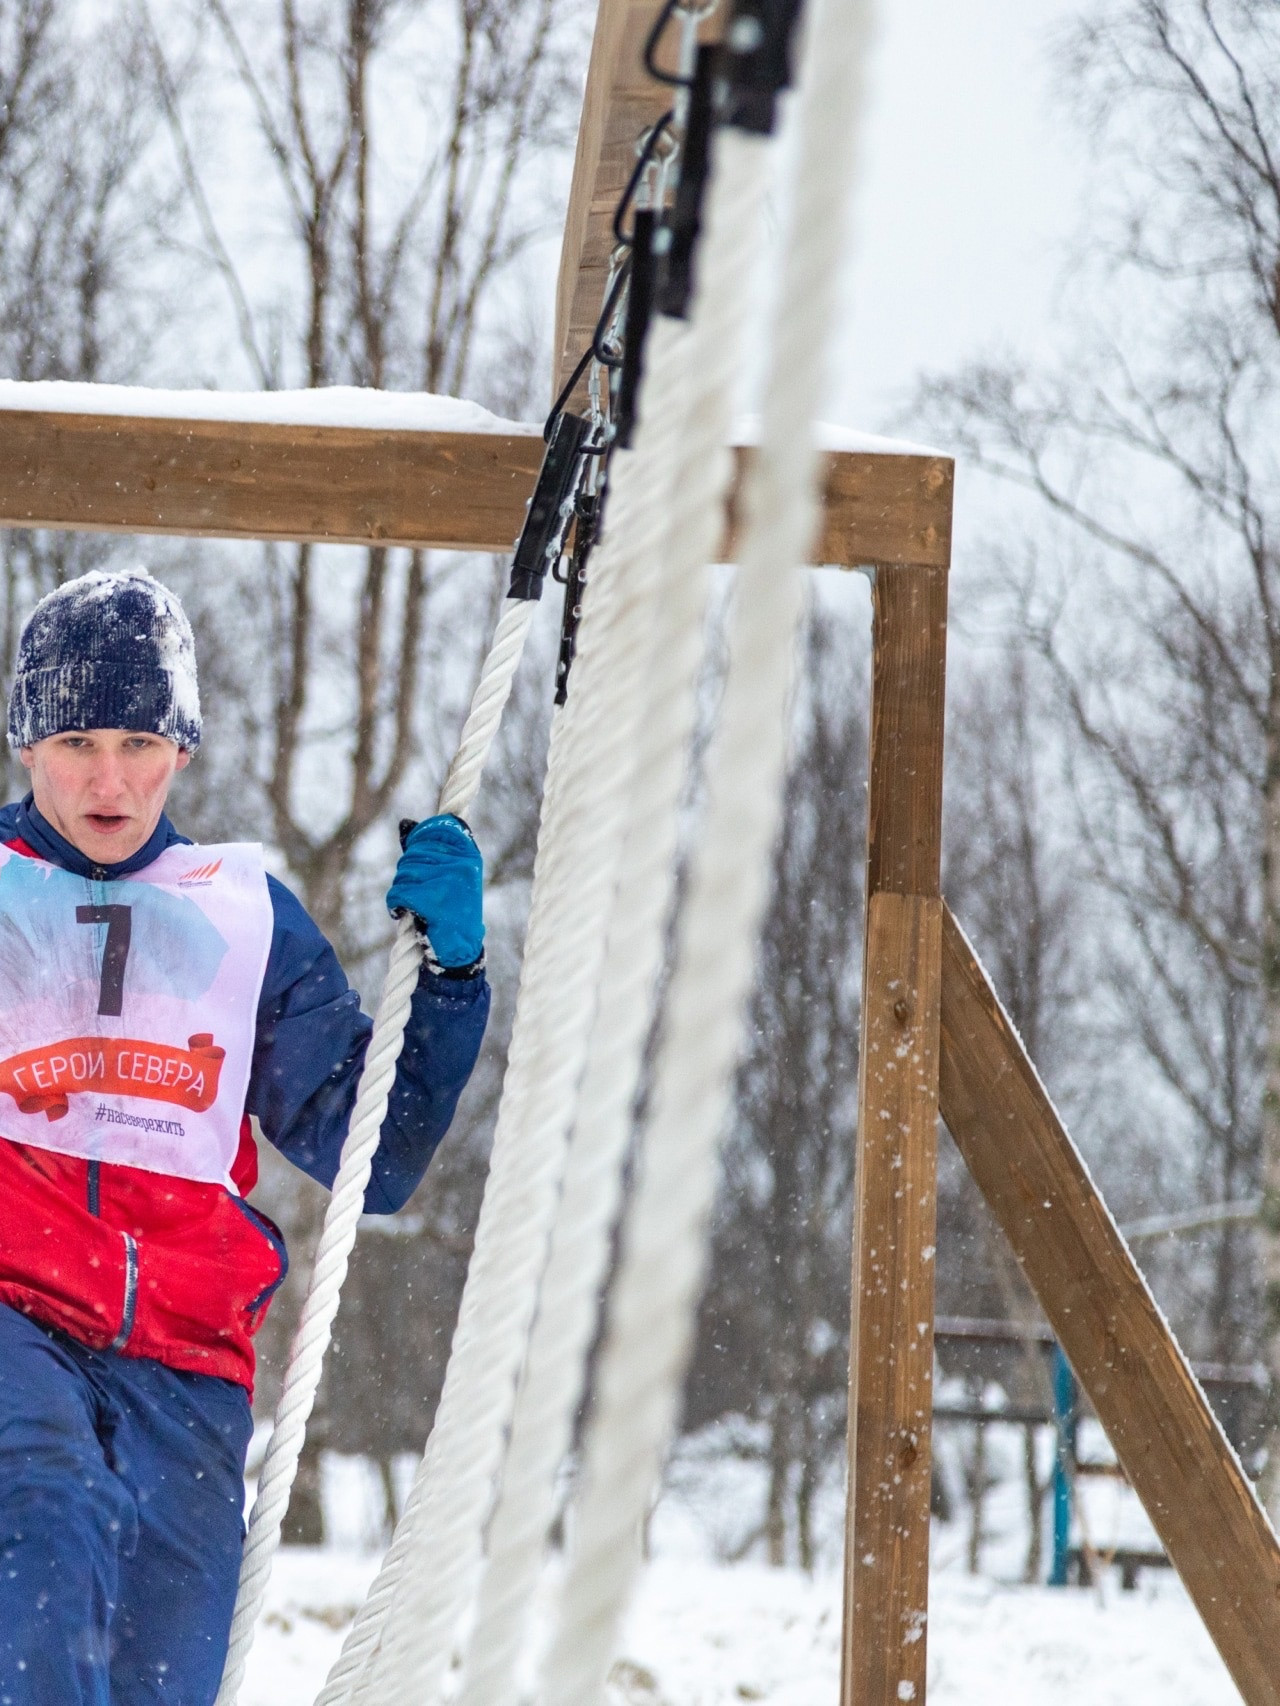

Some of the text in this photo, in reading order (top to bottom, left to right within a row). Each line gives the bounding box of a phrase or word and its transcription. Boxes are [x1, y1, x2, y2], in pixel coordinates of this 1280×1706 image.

[76, 905, 131, 1016] 7
[13, 1051, 205, 1097] ГЕРОИ СЕВЕРА
[95, 1103, 185, 1137] #насевережить
